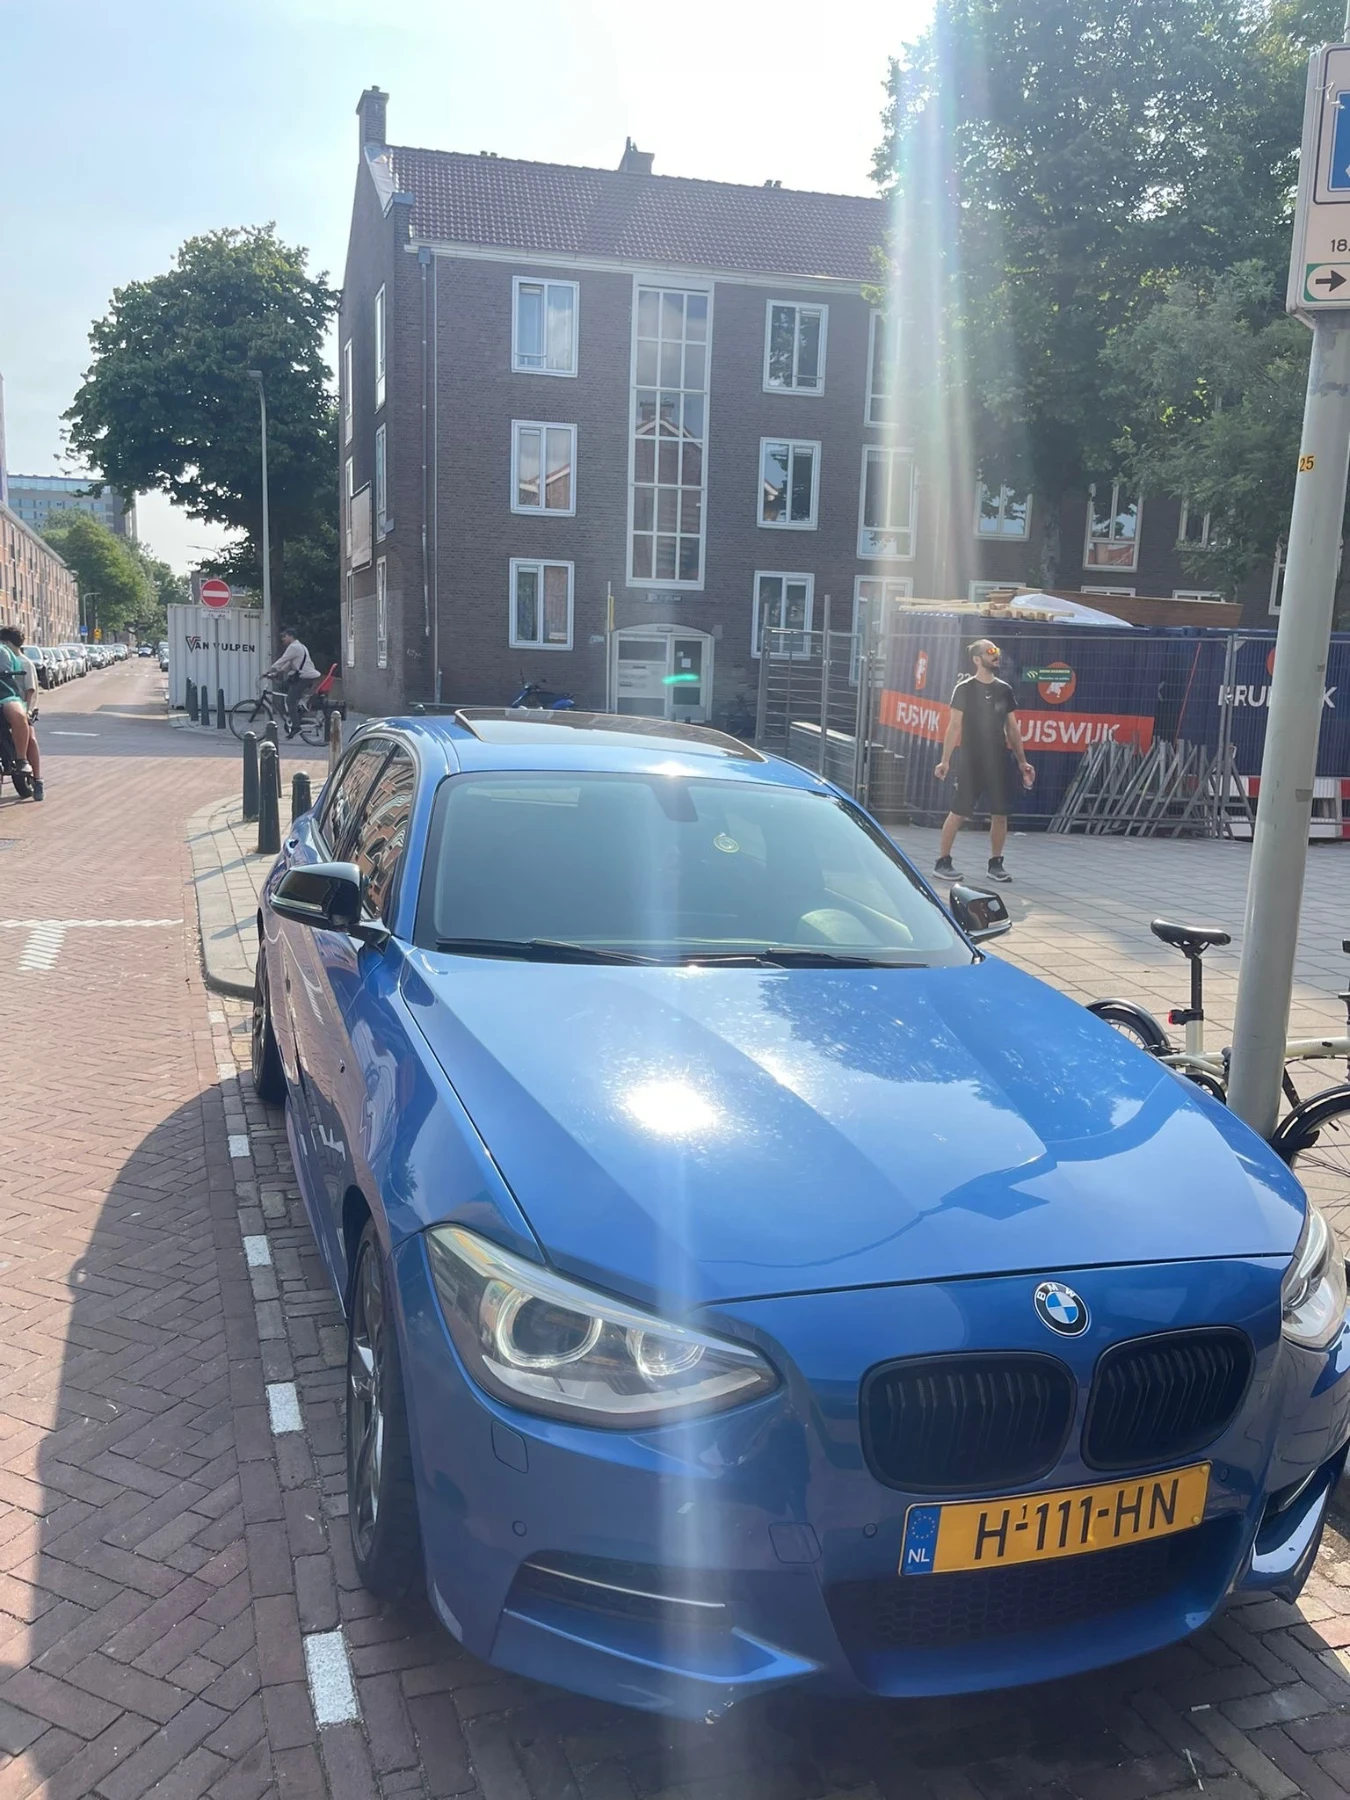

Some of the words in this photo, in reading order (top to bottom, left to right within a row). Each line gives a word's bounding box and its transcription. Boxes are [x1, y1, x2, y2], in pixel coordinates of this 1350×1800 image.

[1299, 455, 1315, 472] 25
[185, 636, 210, 653] VAN
[213, 642, 256, 653] VULPEN
[1036, 1283, 1077, 1302] BMW
[973, 1478, 1180, 1561] H-111-HN
[907, 1548, 931, 1565] NL
